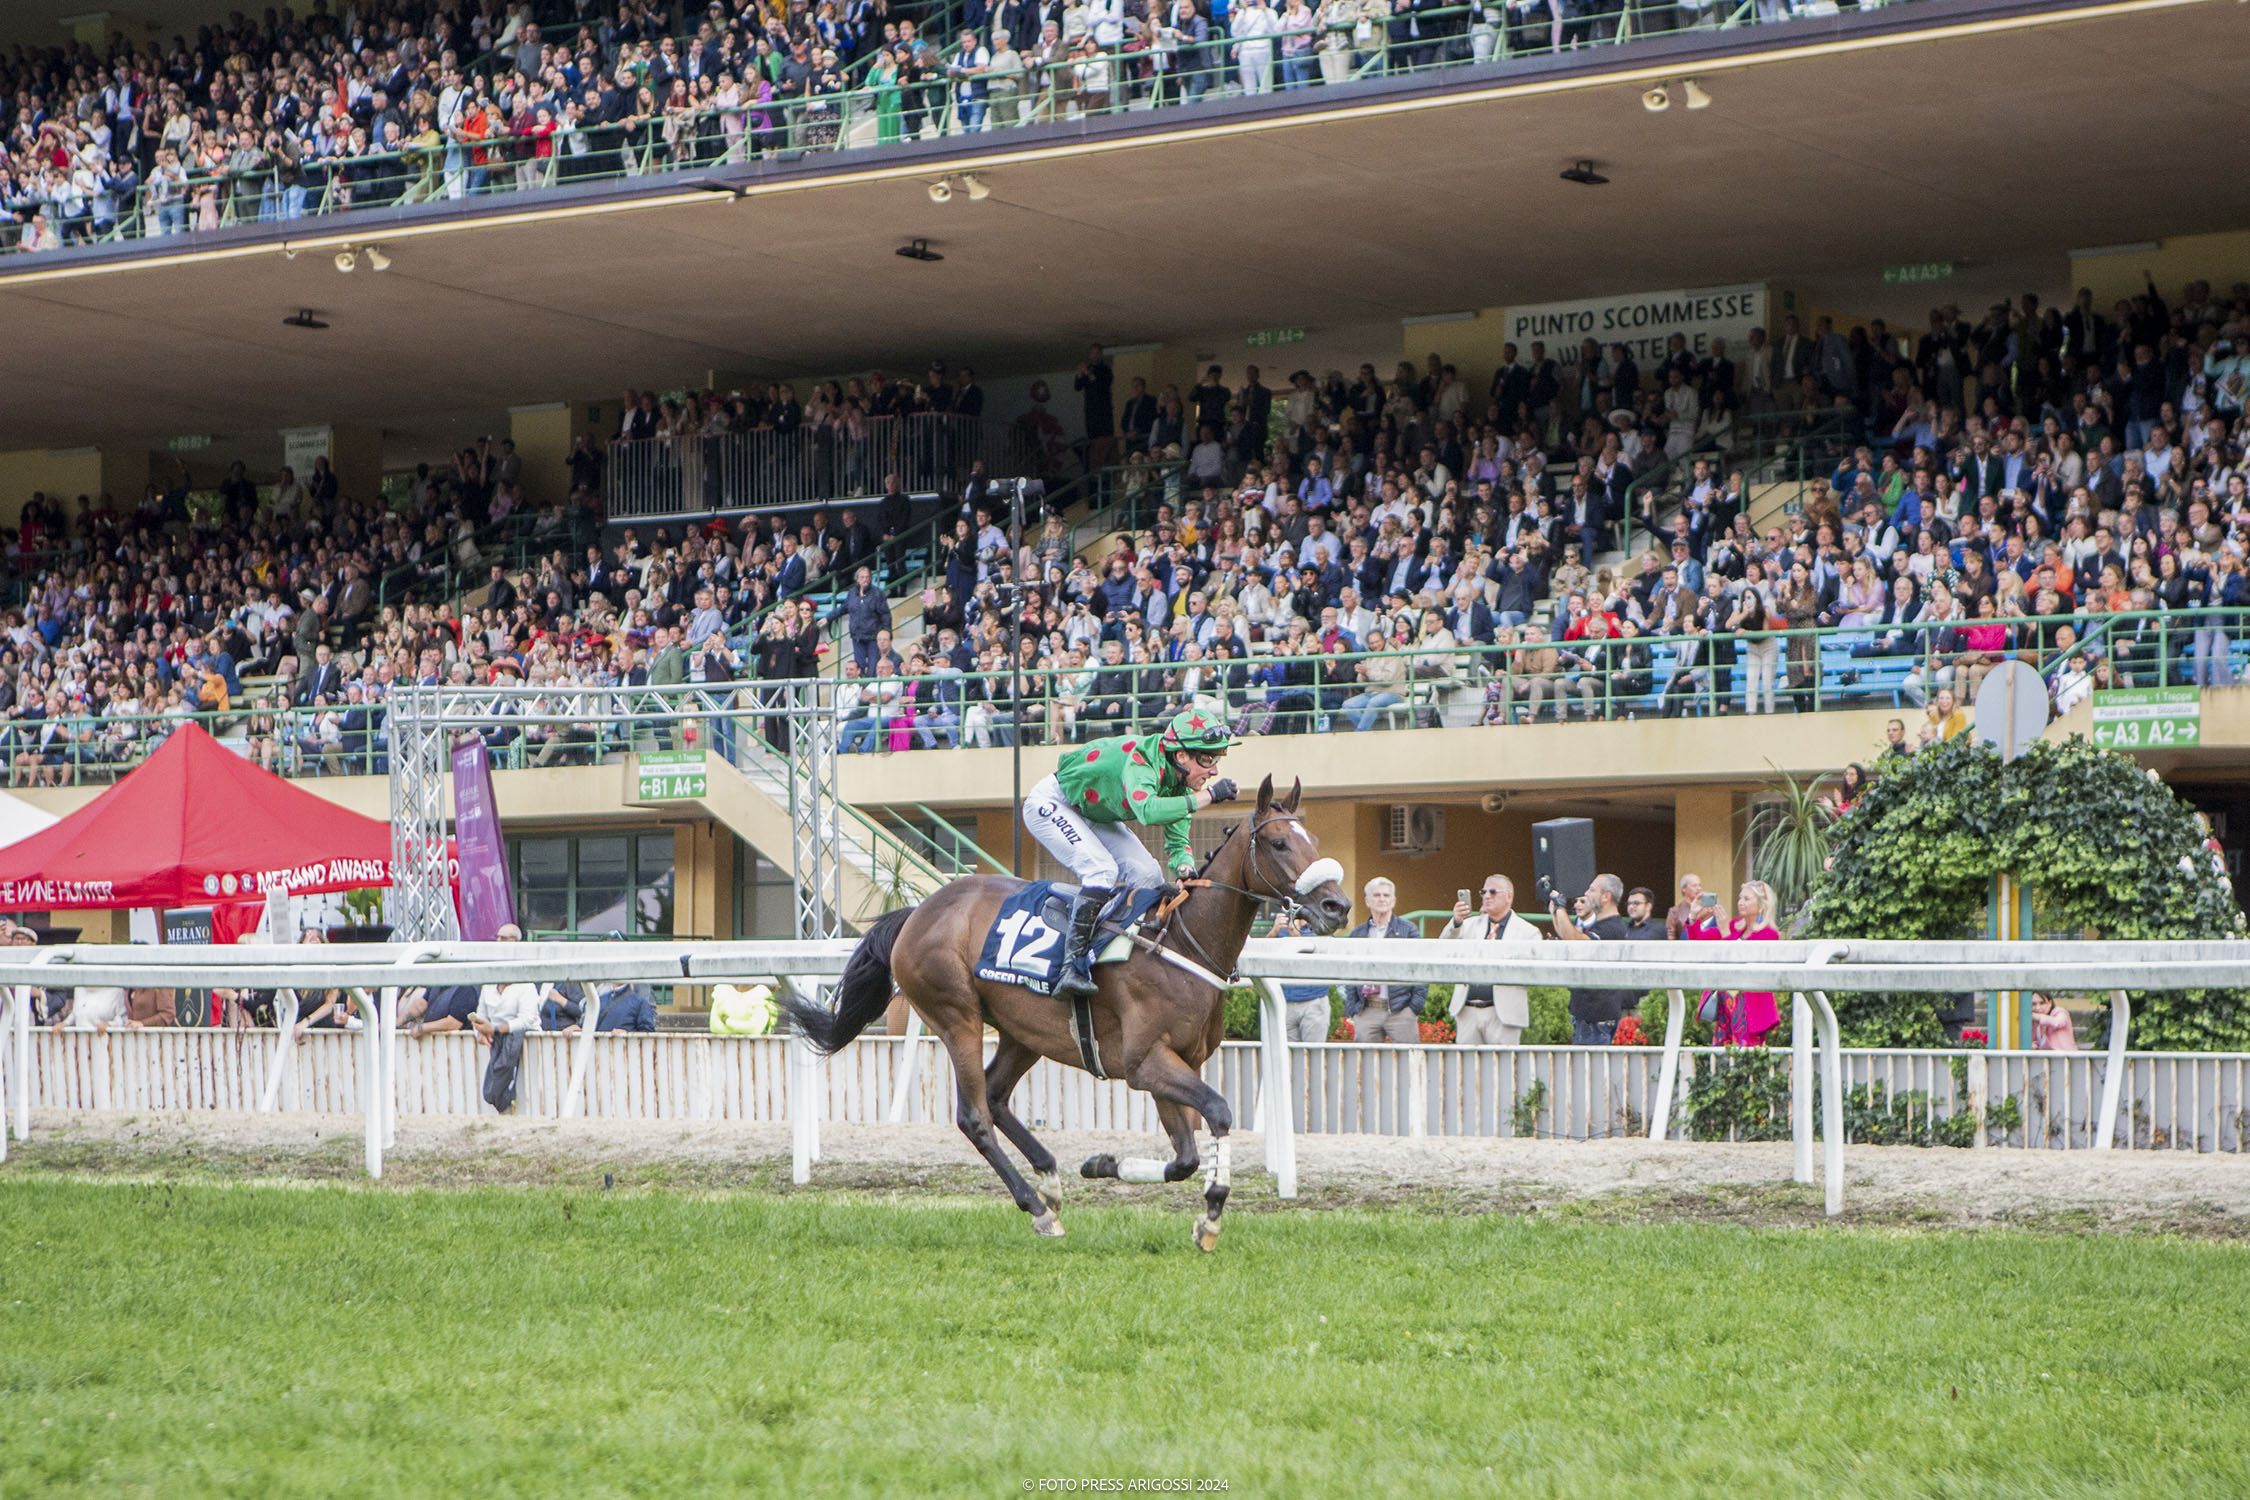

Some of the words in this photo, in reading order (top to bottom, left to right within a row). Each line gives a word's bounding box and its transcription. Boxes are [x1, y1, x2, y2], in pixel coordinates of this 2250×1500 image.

[1516, 310, 1594, 338] PUNTO
[1603, 293, 1754, 331] SCOMMESSE
[2112, 721, 2139, 746] A3
[2148, 720, 2175, 744] A2
[652, 778, 667, 797] B1
[674, 776, 691, 796] A4
[1052, 816, 1082, 845] JOCKIZ
[257, 863, 326, 893] MERANO
[329, 859, 384, 882] AWARD
[0, 881, 15, 903] HE
[17, 880, 56, 903] WINE
[57, 880, 115, 902] HUNTER
[167, 925, 210, 941] MERANO
[996, 909, 1060, 977] 12
